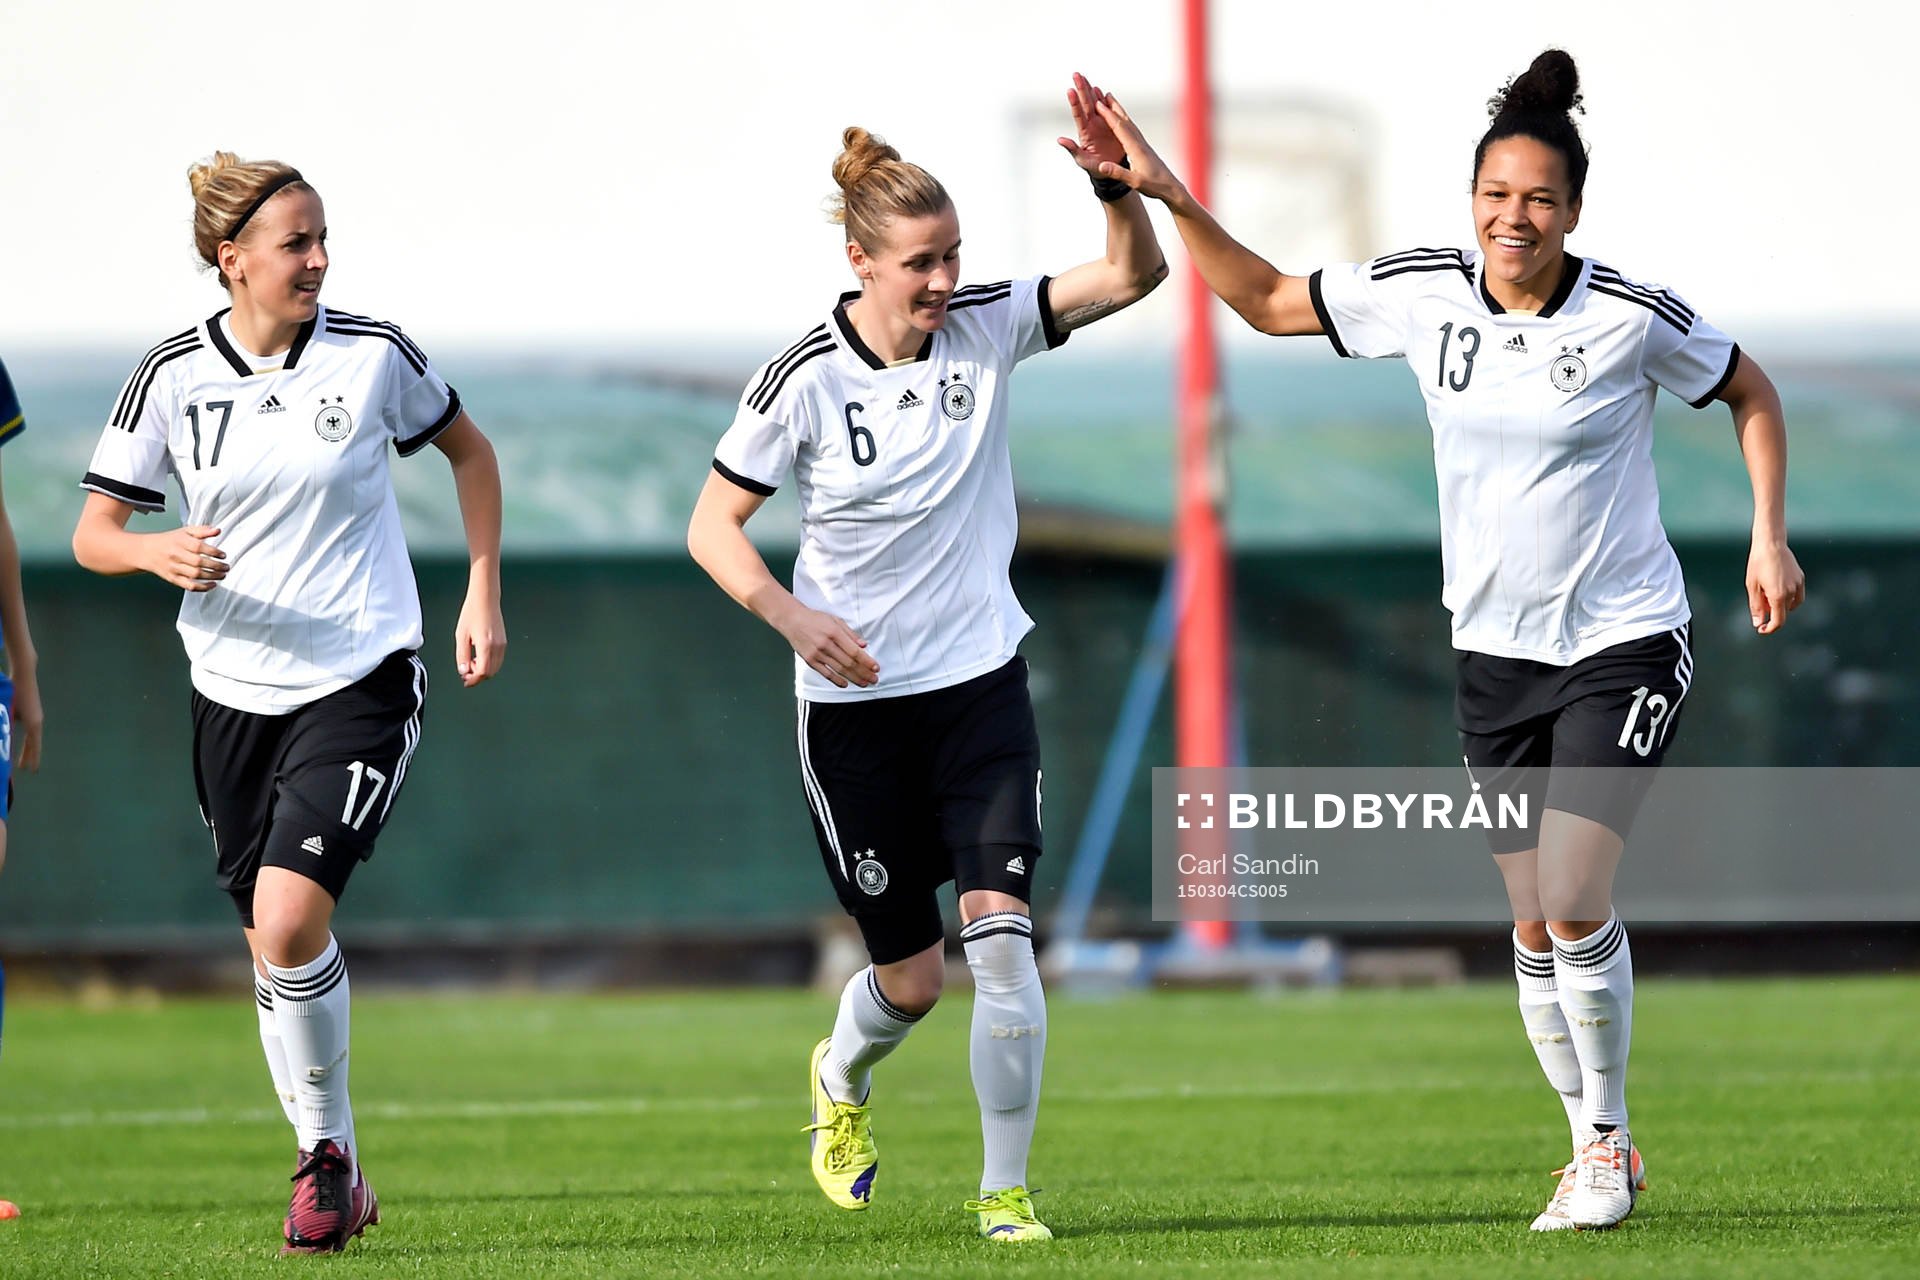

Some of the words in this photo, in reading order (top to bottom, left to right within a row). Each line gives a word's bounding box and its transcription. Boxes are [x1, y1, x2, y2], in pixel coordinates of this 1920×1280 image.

[1438, 321, 1481, 393] 13
[1502, 343, 1528, 354] adidas
[184, 400, 235, 471] 17
[257, 406, 287, 414] adidas
[844, 401, 877, 467] 6
[897, 400, 924, 410] adidas
[1617, 685, 1668, 757] 13
[341, 760, 386, 832] 17
